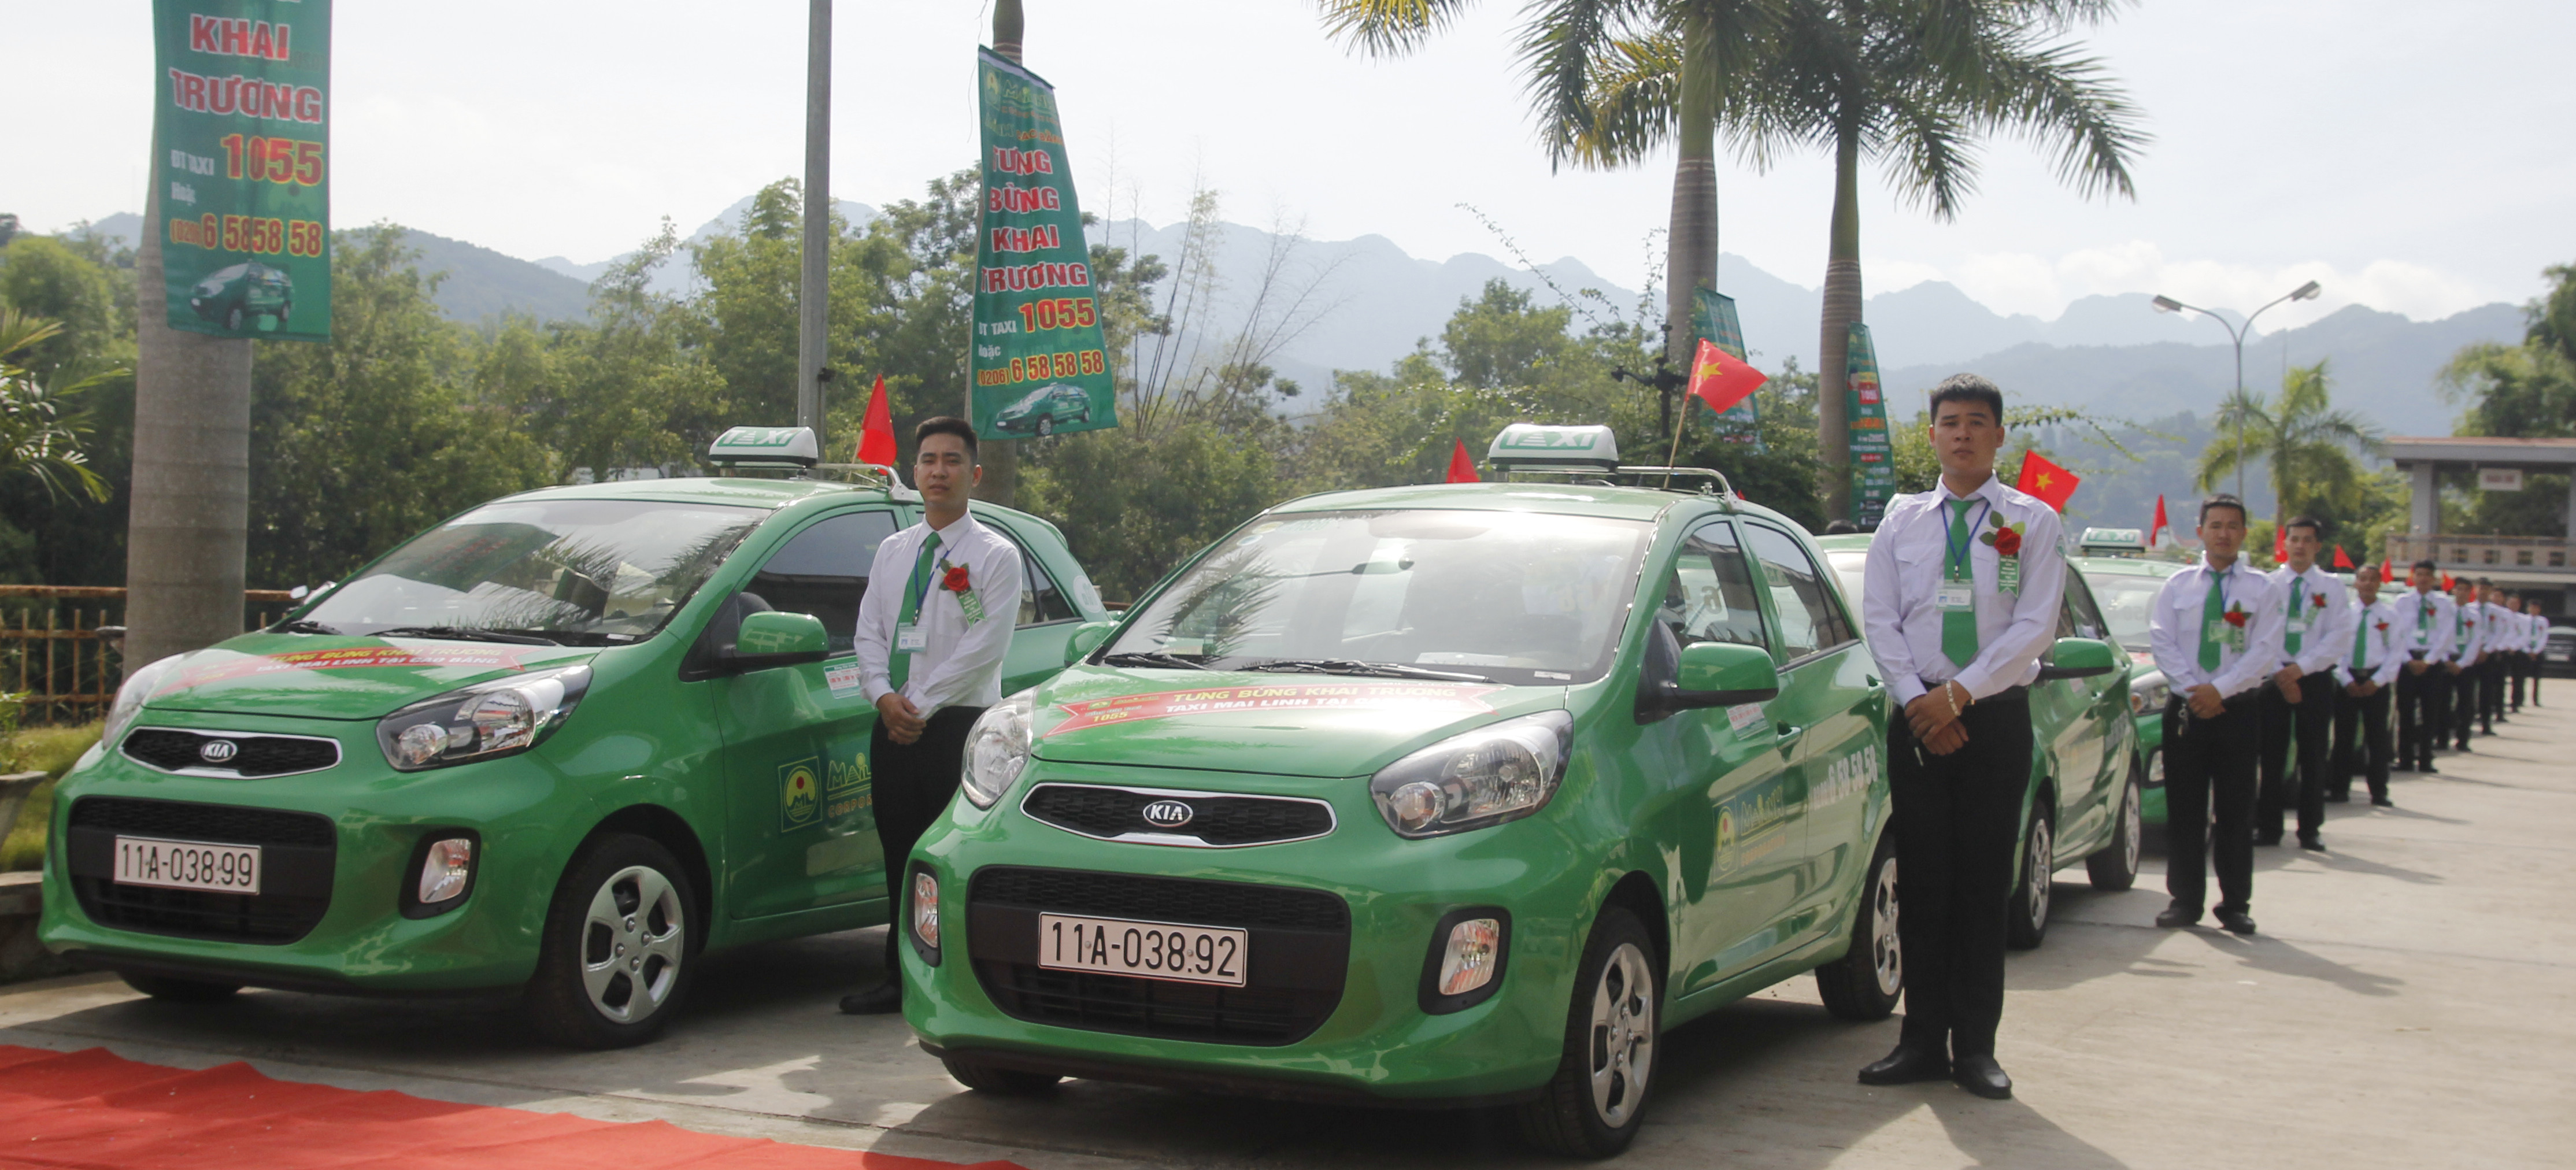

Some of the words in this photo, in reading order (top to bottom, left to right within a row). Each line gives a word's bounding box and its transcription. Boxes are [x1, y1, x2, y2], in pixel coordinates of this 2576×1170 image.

[190, 13, 290, 61] KHAI
[169, 66, 322, 124] TRƯƠNG
[220, 134, 323, 186] 1055
[989, 182, 1061, 214] BỪNG
[288, 219, 323, 258] 58
[991, 224, 1060, 253] KHAI
[981, 262, 1089, 293] TRƯƠNG
[991, 320, 1016, 335] TAXI
[1019, 297, 1096, 333] 1055
[977, 368, 1011, 387] (0206)
[1009, 357, 1024, 383] 6
[1026, 354, 1051, 380] 58
[1053, 351, 1077, 378] 58
[1080, 349, 1105, 375] 58
[376, 648, 423, 657] KHAI
[1166, 704, 1207, 713] TAXI
[1213, 700, 1254, 709] MAI
[1260, 698, 1309, 706] LINH
[1174, 691, 1230, 702] TƯNG
[1305, 687, 1359, 695] KHAI
[1093, 712, 1128, 722] 1055
[204, 743, 230, 757] KIA
[1150, 804, 1183, 821] KIA
[123, 843, 253, 887] 11A-038.99
[1052, 921, 1237, 978] 11A-038.92
